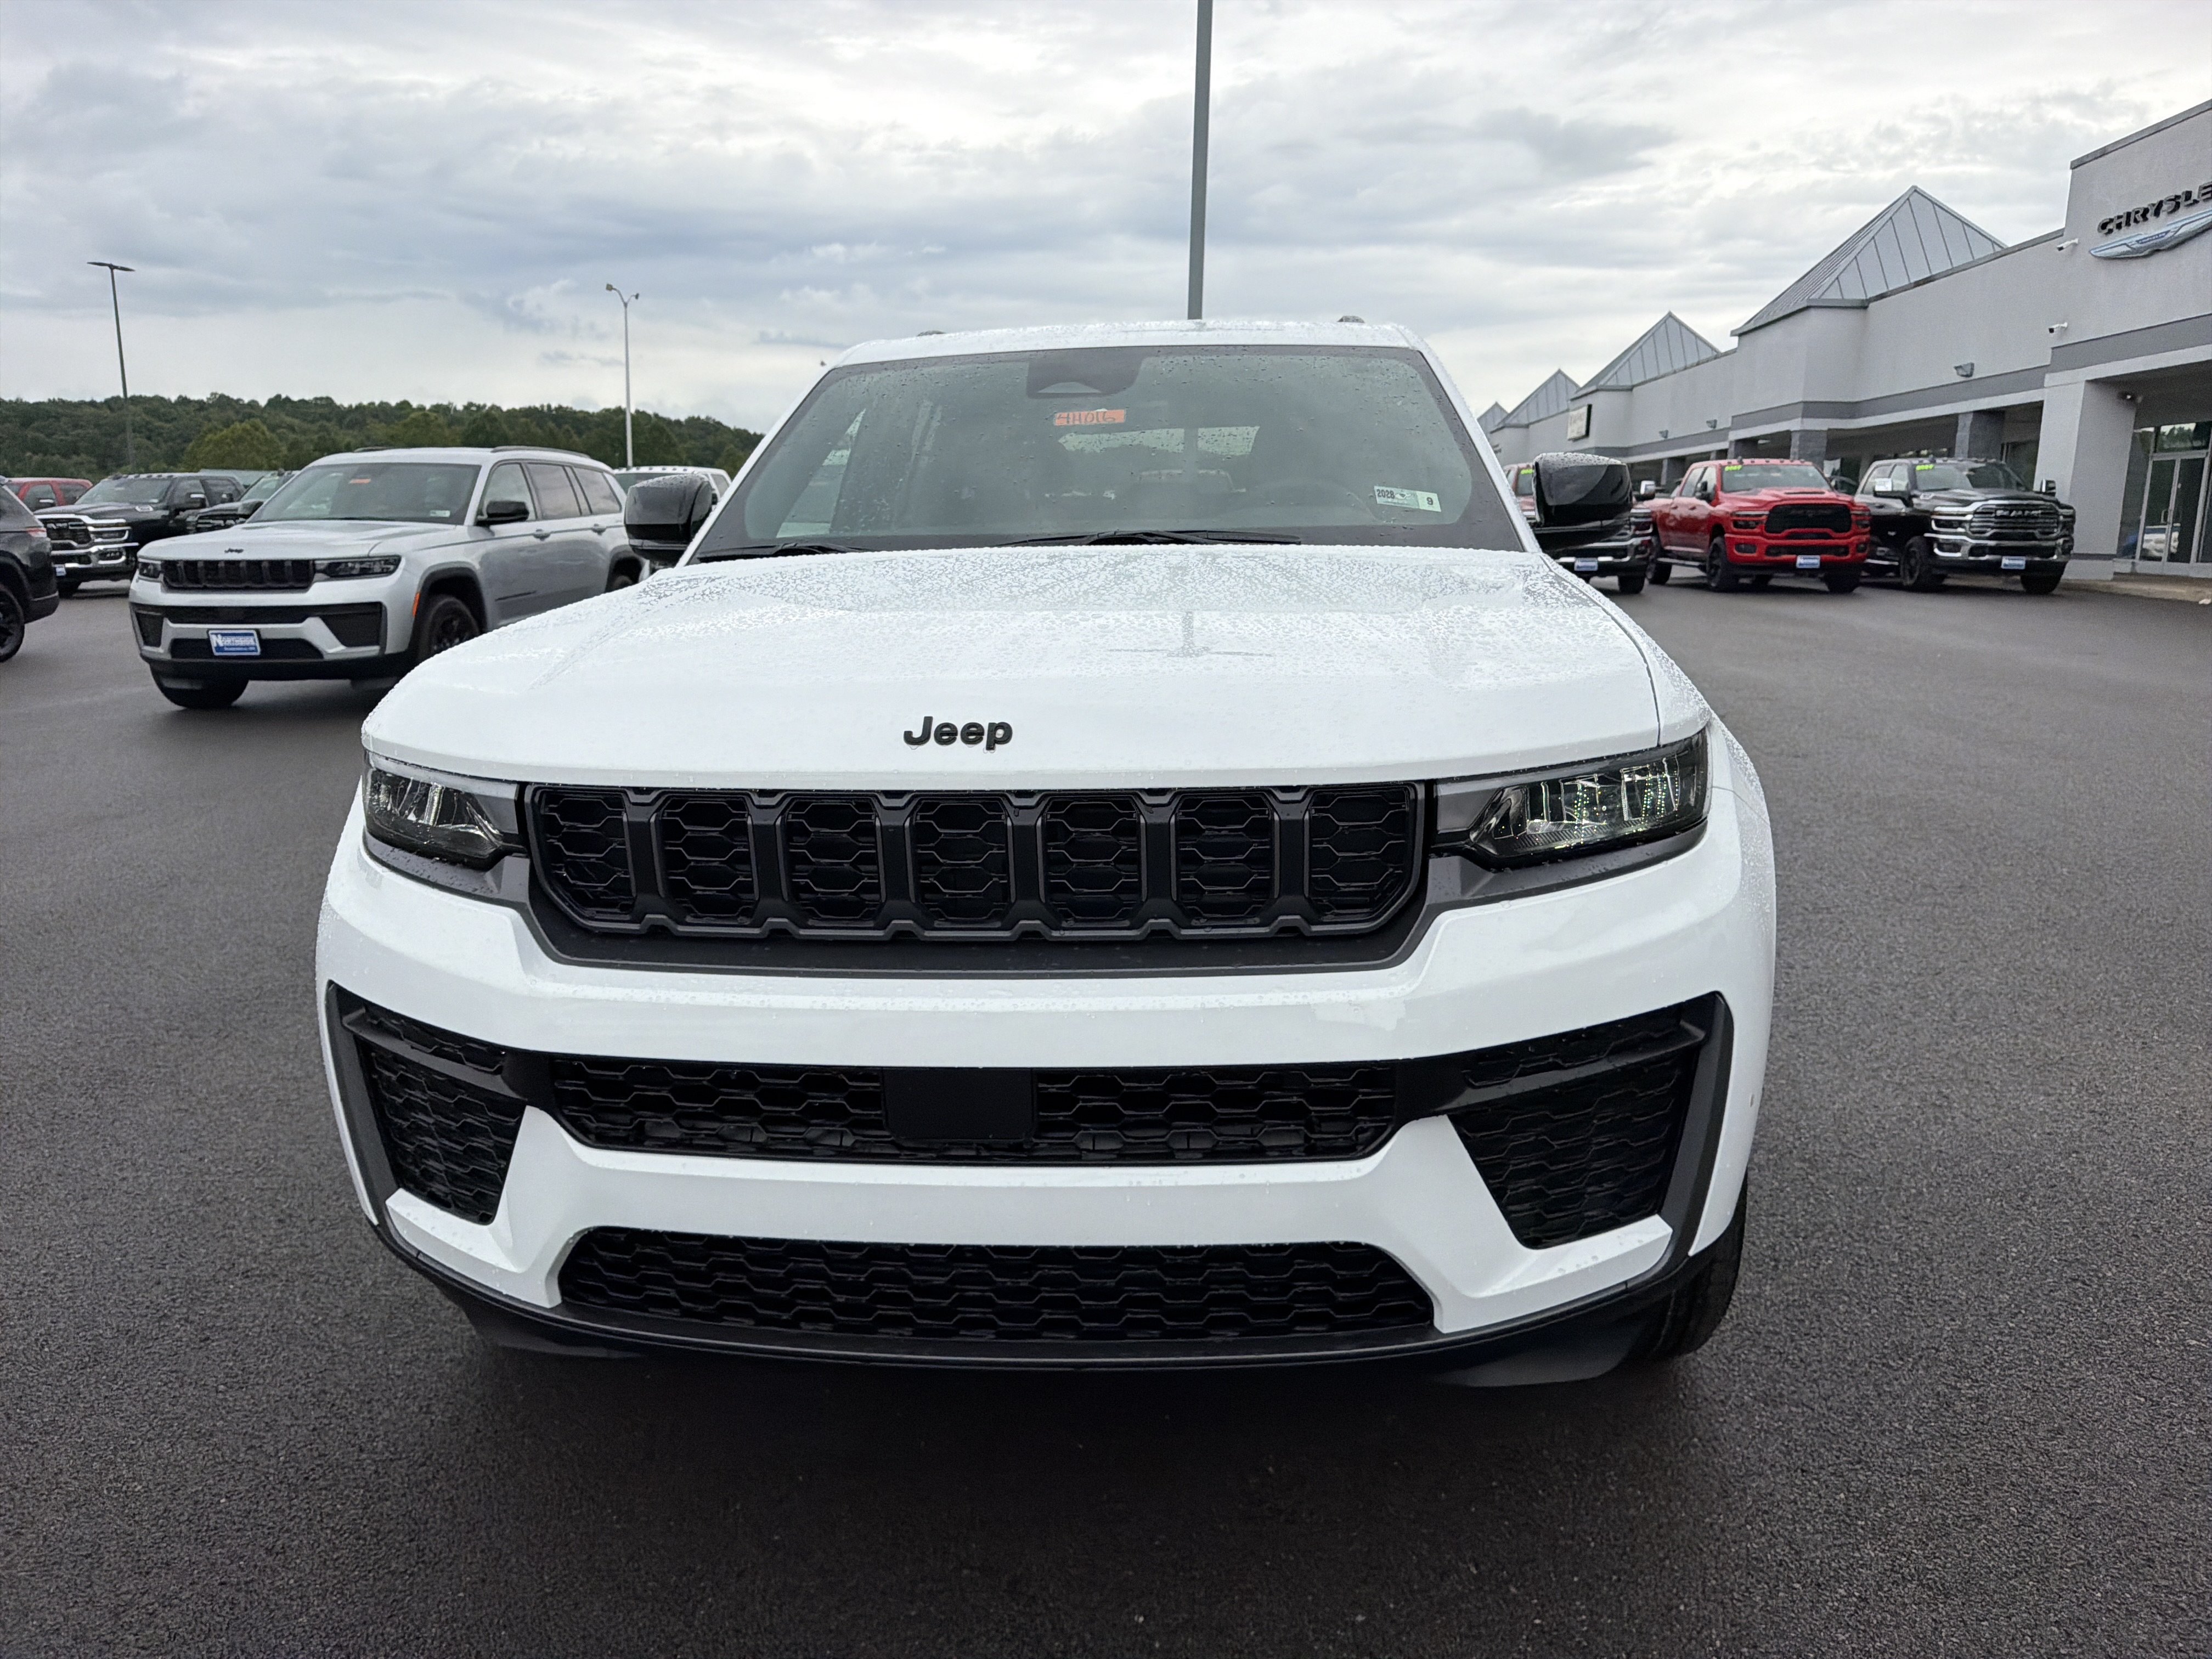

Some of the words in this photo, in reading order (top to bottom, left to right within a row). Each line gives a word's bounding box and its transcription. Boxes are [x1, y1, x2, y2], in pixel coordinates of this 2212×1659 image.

[1376, 488, 1395, 499] 2028
[1426, 496, 1434, 506] 9
[904, 716, 1013, 751] Jeep
